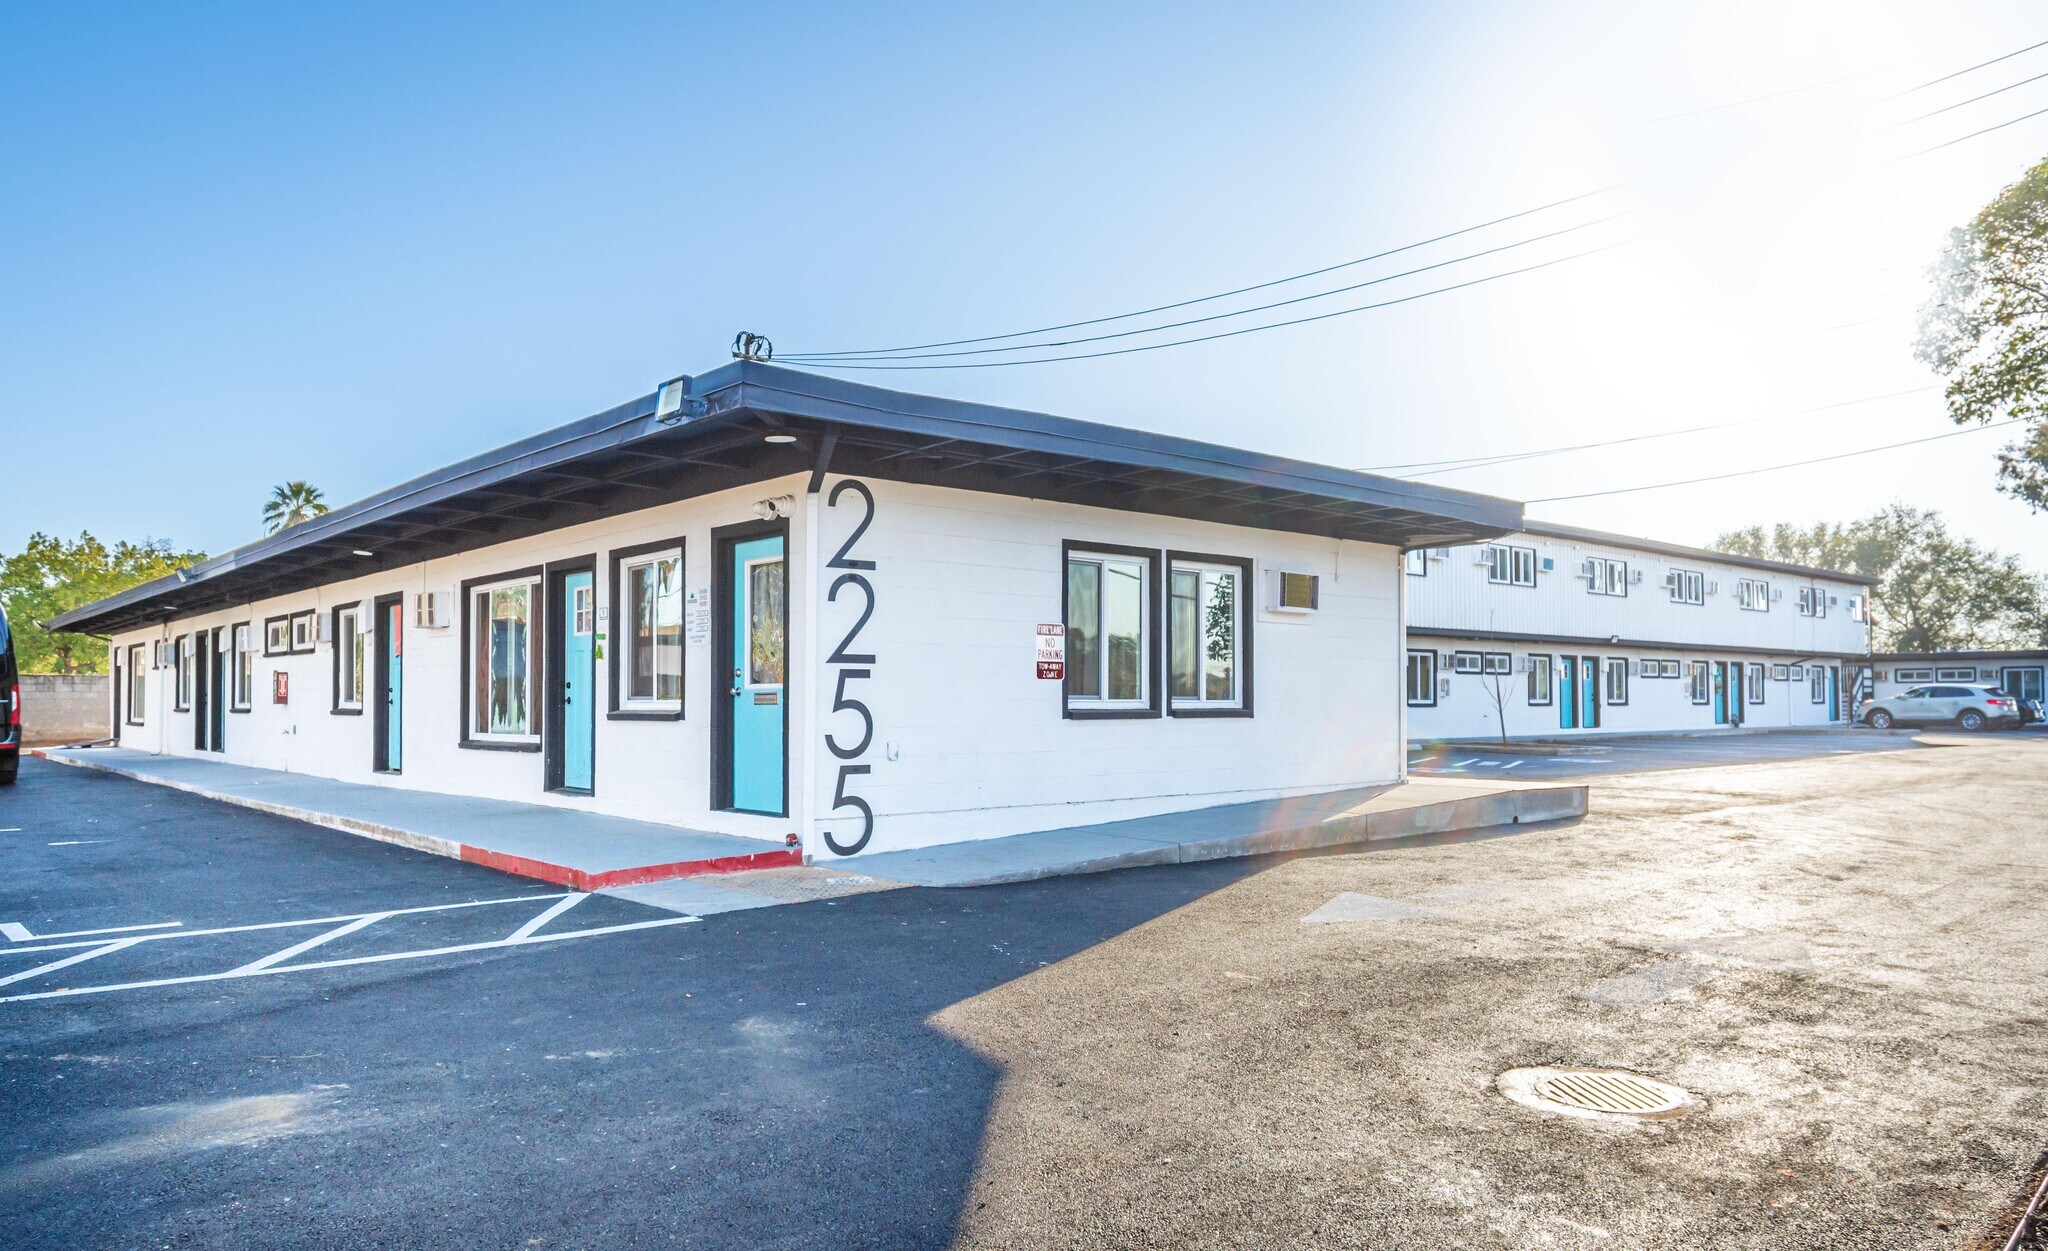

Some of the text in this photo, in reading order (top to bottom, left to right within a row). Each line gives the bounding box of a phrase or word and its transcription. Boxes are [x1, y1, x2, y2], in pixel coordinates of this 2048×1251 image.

[1037, 625, 1063, 635] FIRE LANE
[1045, 638, 1055, 648] NO
[1037, 649, 1063, 660] PARKING
[823, 479, 876, 857] 2255
